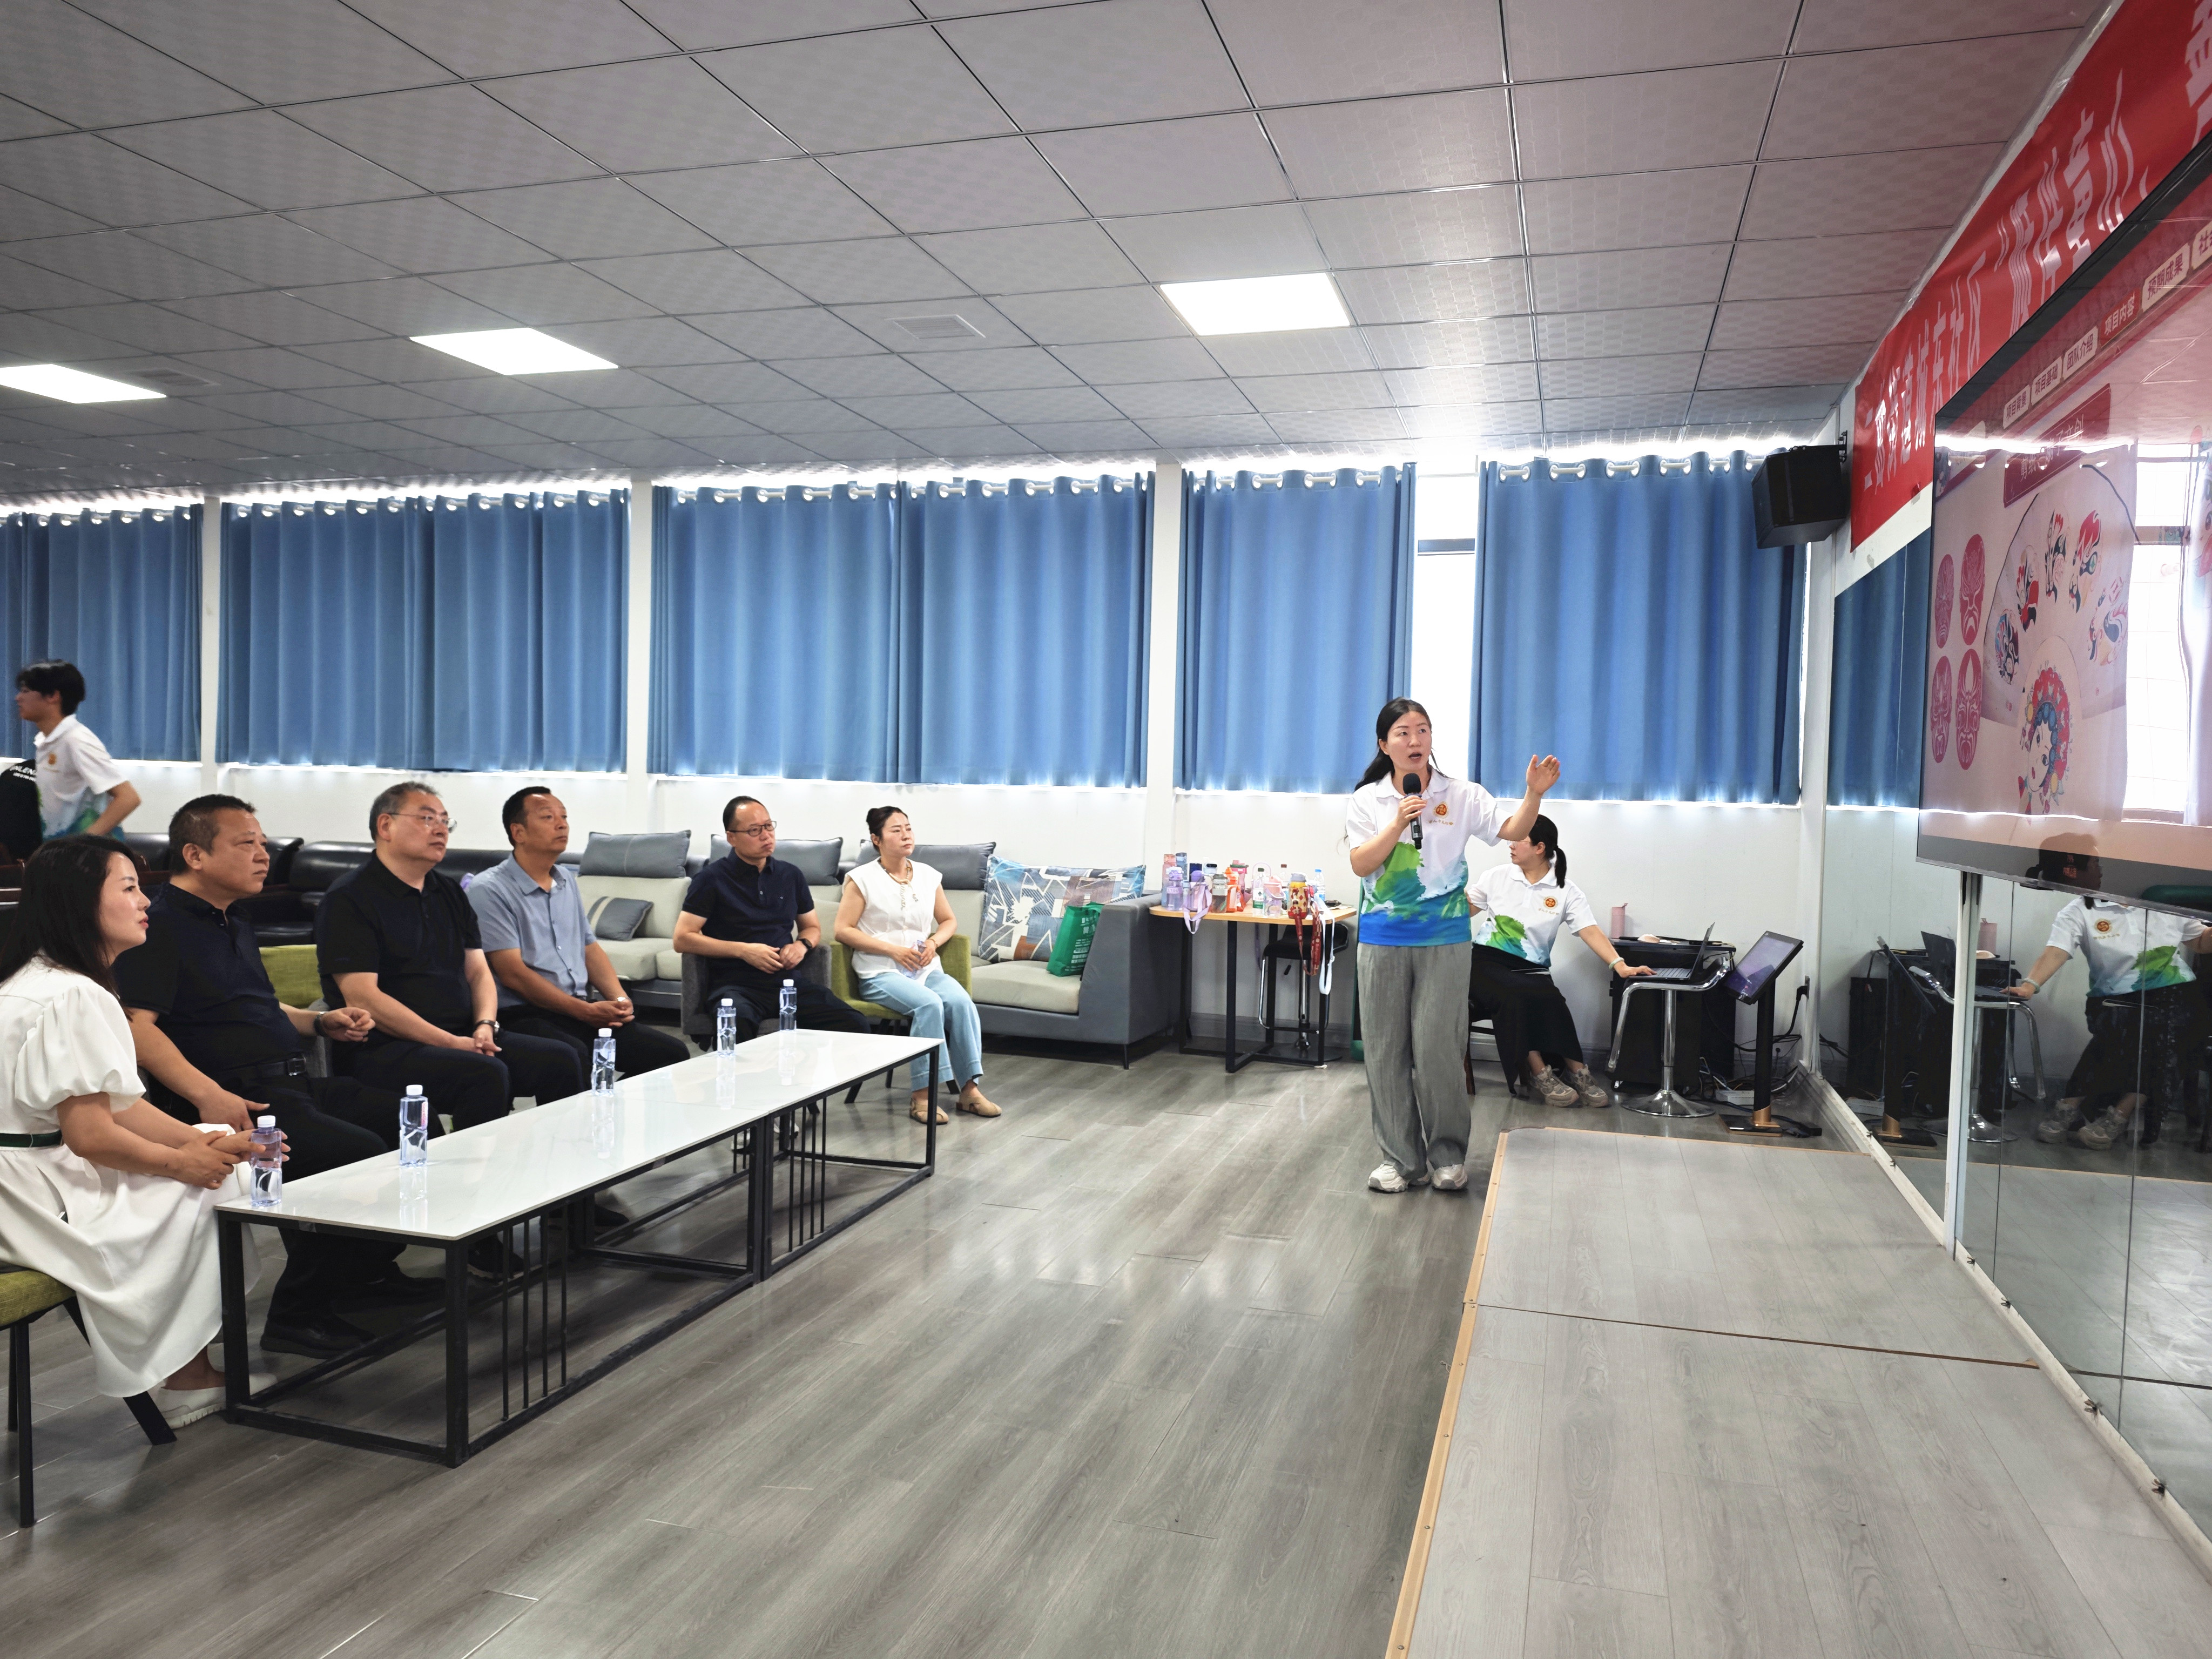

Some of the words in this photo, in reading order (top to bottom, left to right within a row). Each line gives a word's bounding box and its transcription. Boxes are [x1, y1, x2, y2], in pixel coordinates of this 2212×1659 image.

[2147, 252, 2183, 300] 预期成果
[2104, 291, 2135, 335] 项目内容
[2067, 333, 2094, 370] 团队介绍
[2035, 363, 2058, 395] 项目基础
[2006, 390, 2027, 420] 项目背景
